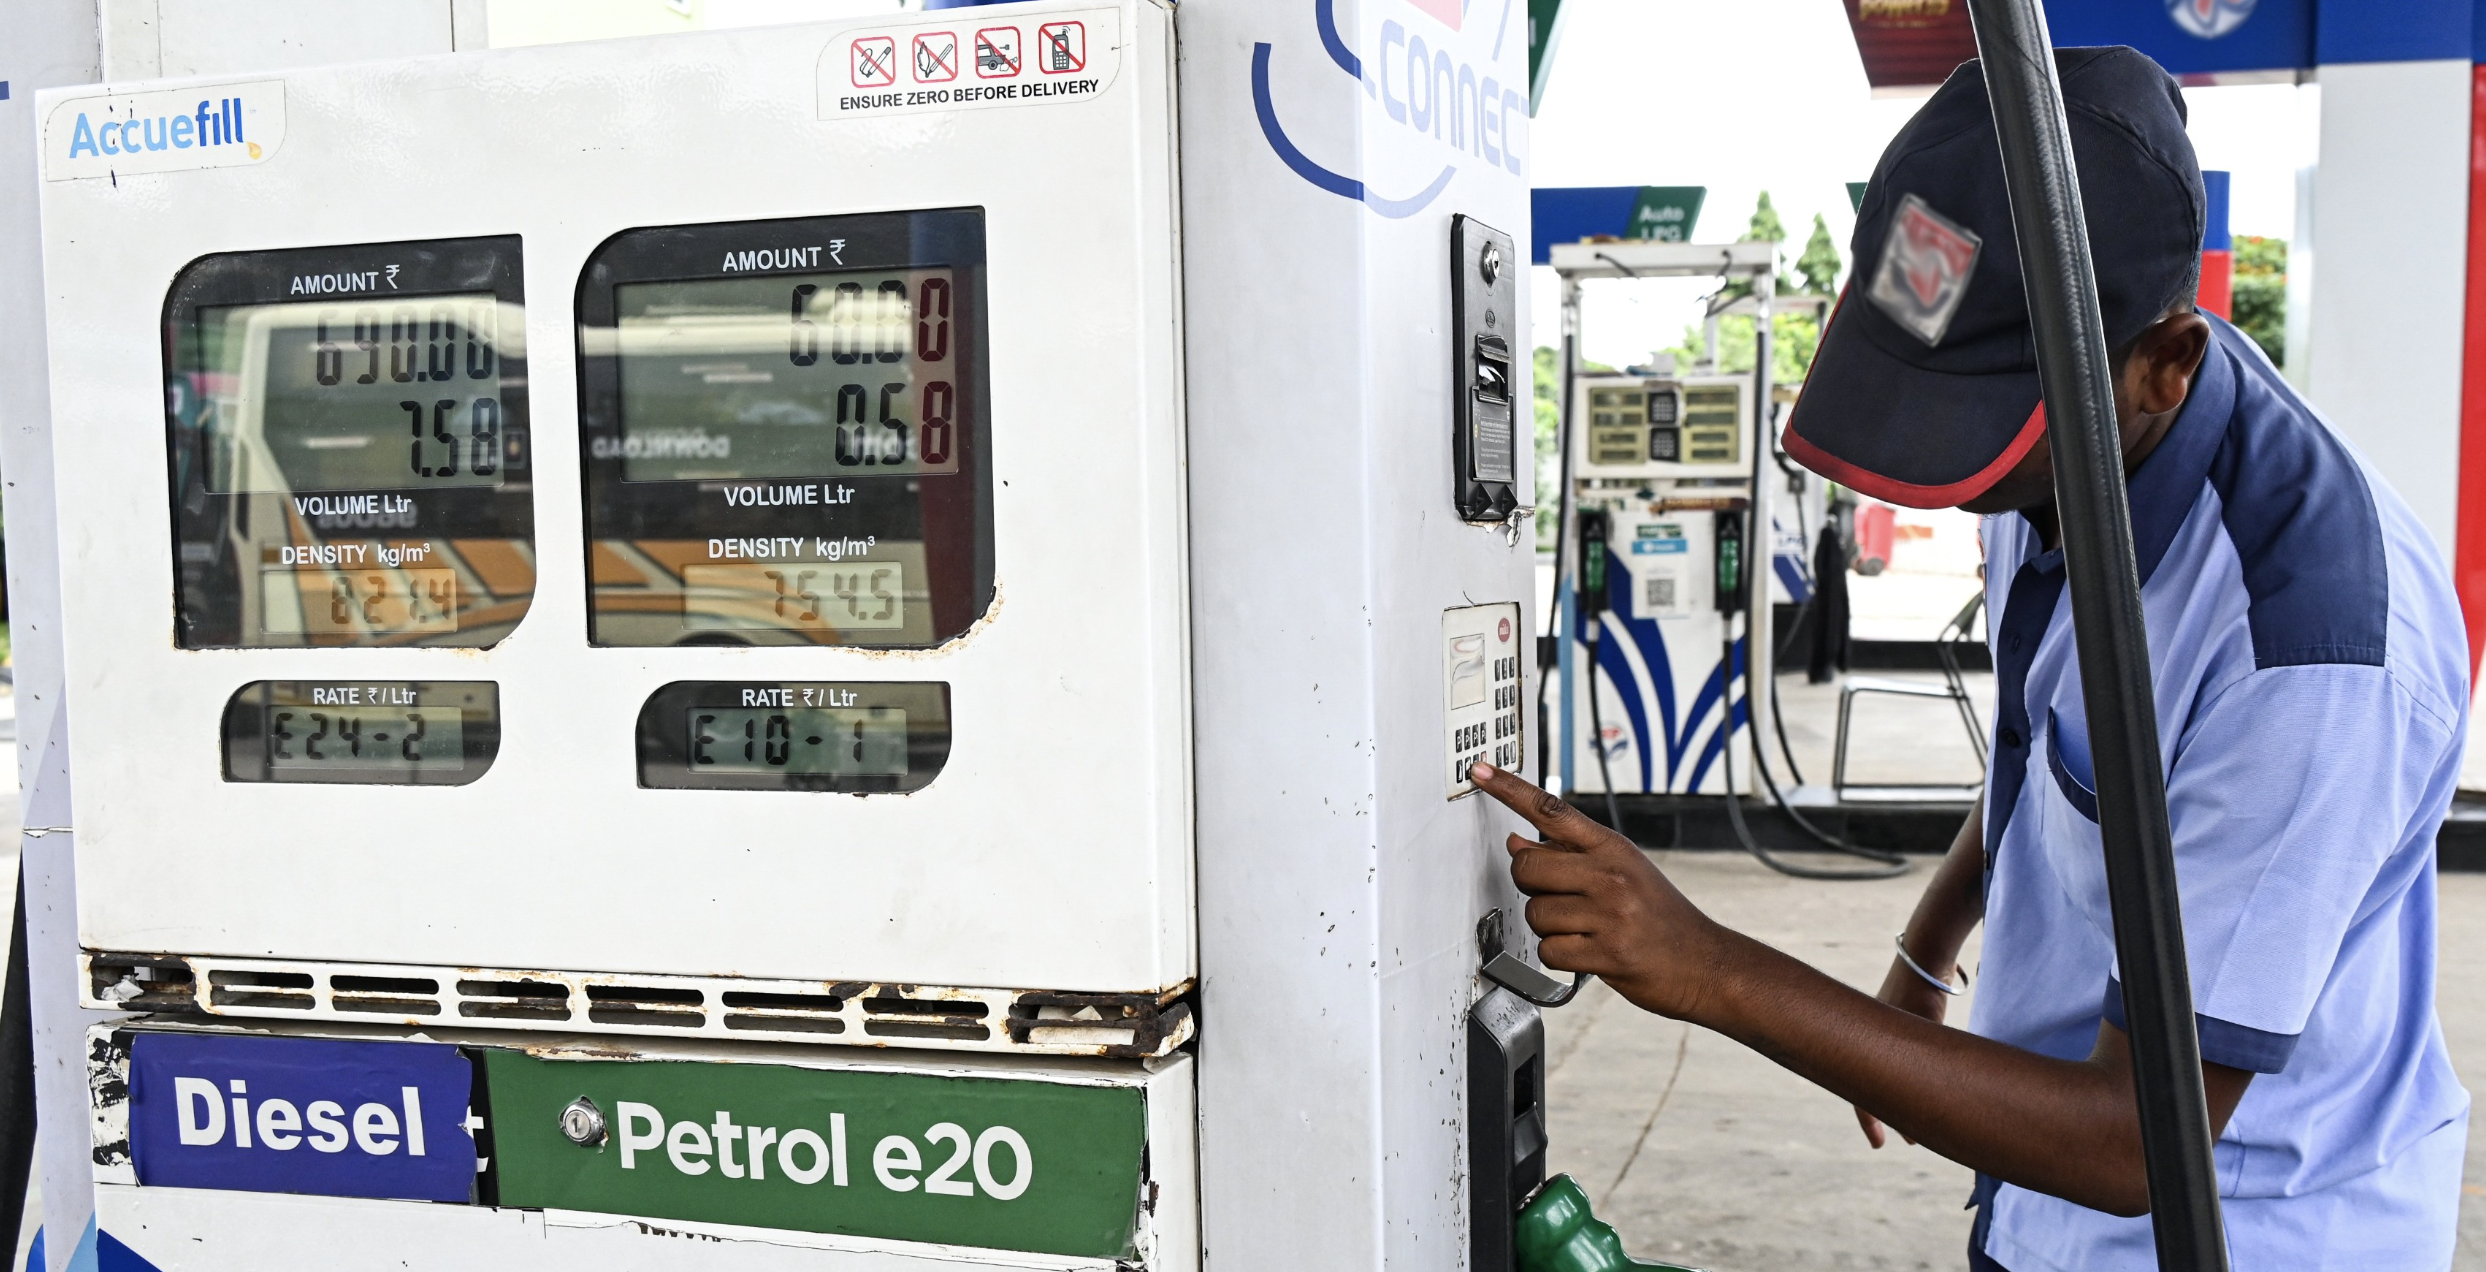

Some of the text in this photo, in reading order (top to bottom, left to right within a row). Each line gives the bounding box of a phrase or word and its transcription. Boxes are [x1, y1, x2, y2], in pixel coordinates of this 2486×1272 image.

[840, 79, 1099, 110] ENSURE ZERO BEFORE DELIVERY
[69, 97, 244, 159] Accuefill
[722, 246, 822, 272] AMOUNT
[290, 271, 379, 295] AMOUNT
[789, 277, 950, 367] 60.00
[316, 301, 495, 386] 690.00
[399, 397, 498, 478] 7.58
[835, 381, 952, 466] 0.58
[295, 494, 413, 516] VOLUME Ltr
[723, 484, 856, 507] VOLUME Ltr
[281, 544, 368, 565] DENSITY
[708, 537, 804, 558] DENSITY
[331, 575, 451, 625] 821.4
[764, 568, 894, 621] 754.5
[313, 687, 360, 705] RATE
[742, 688, 794, 707] RATE
[174, 1076, 426, 1157] Diesel
[616, 1100, 1033, 1201] Petrol e20
